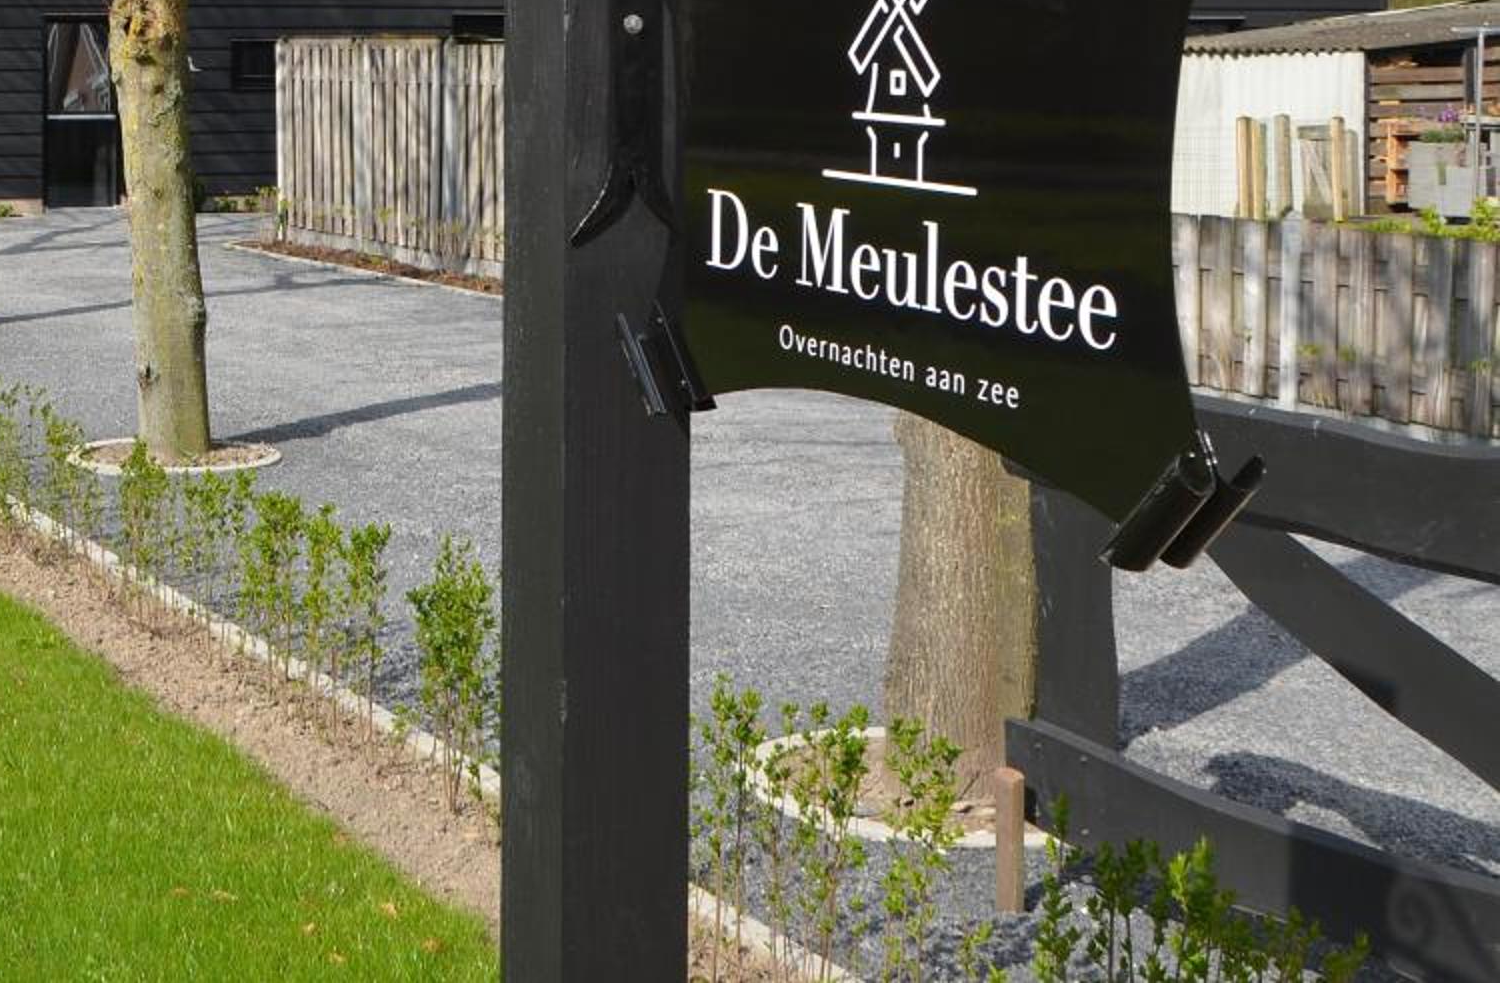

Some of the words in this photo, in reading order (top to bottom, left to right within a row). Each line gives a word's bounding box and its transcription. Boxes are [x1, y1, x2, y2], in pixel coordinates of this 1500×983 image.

[705, 188, 779, 280] De
[795, 202, 1119, 351] Meulestee
[779, 324, 915, 382] Overnachten
[925, 366, 965, 395] aan
[976, 378, 1019, 409] zee
